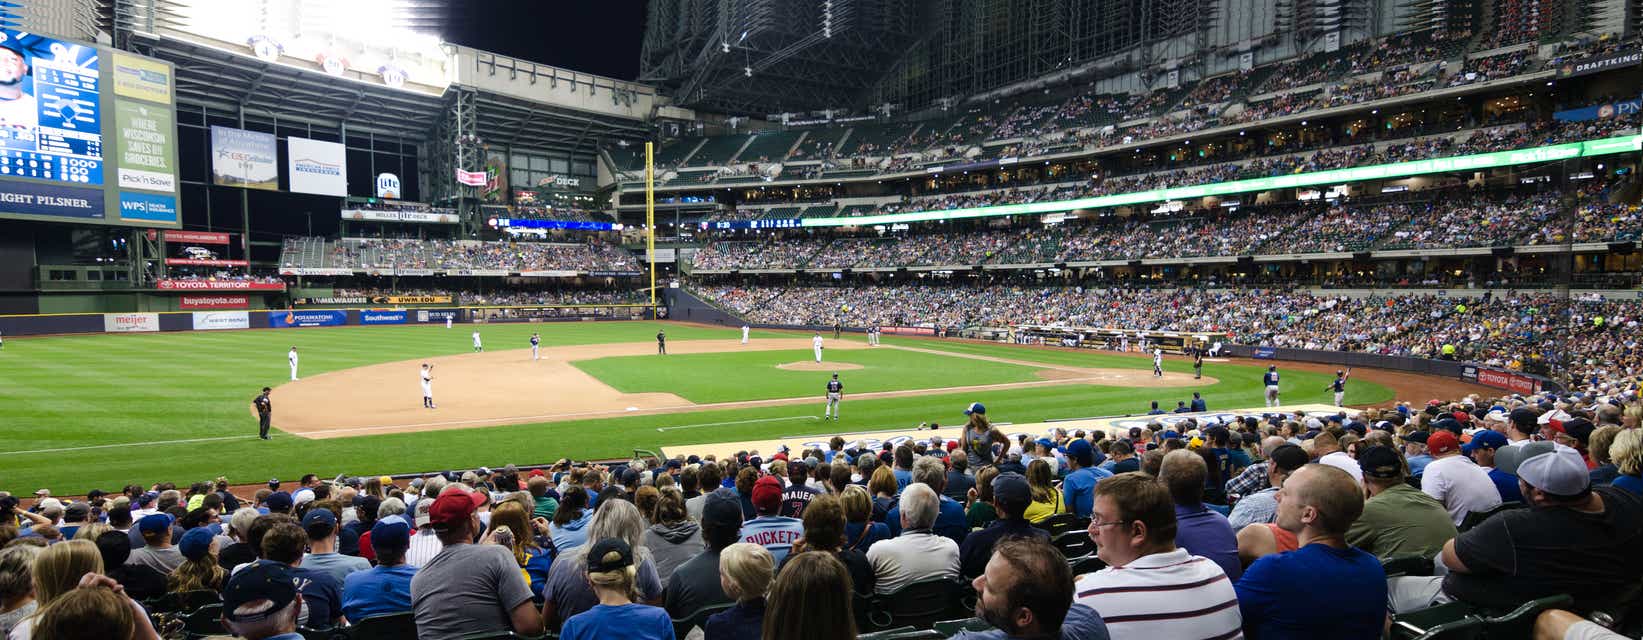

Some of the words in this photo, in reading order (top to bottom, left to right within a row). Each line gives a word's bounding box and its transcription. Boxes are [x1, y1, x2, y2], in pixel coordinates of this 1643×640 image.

[1616, 101, 1642, 114] PN
[0, 193, 34, 204] IGHT
[36, 195, 92, 208] PILSNER.
[122, 201, 145, 211] WPS
[184, 297, 246, 305] buyatoyota.com
[115, 314, 147, 325] meijer
[1487, 373, 1508, 384] TOYOTA
[782, 490, 816, 503] MAUER
[792, 501, 803, 518] 7
[745, 530, 801, 546] PUCKETT
